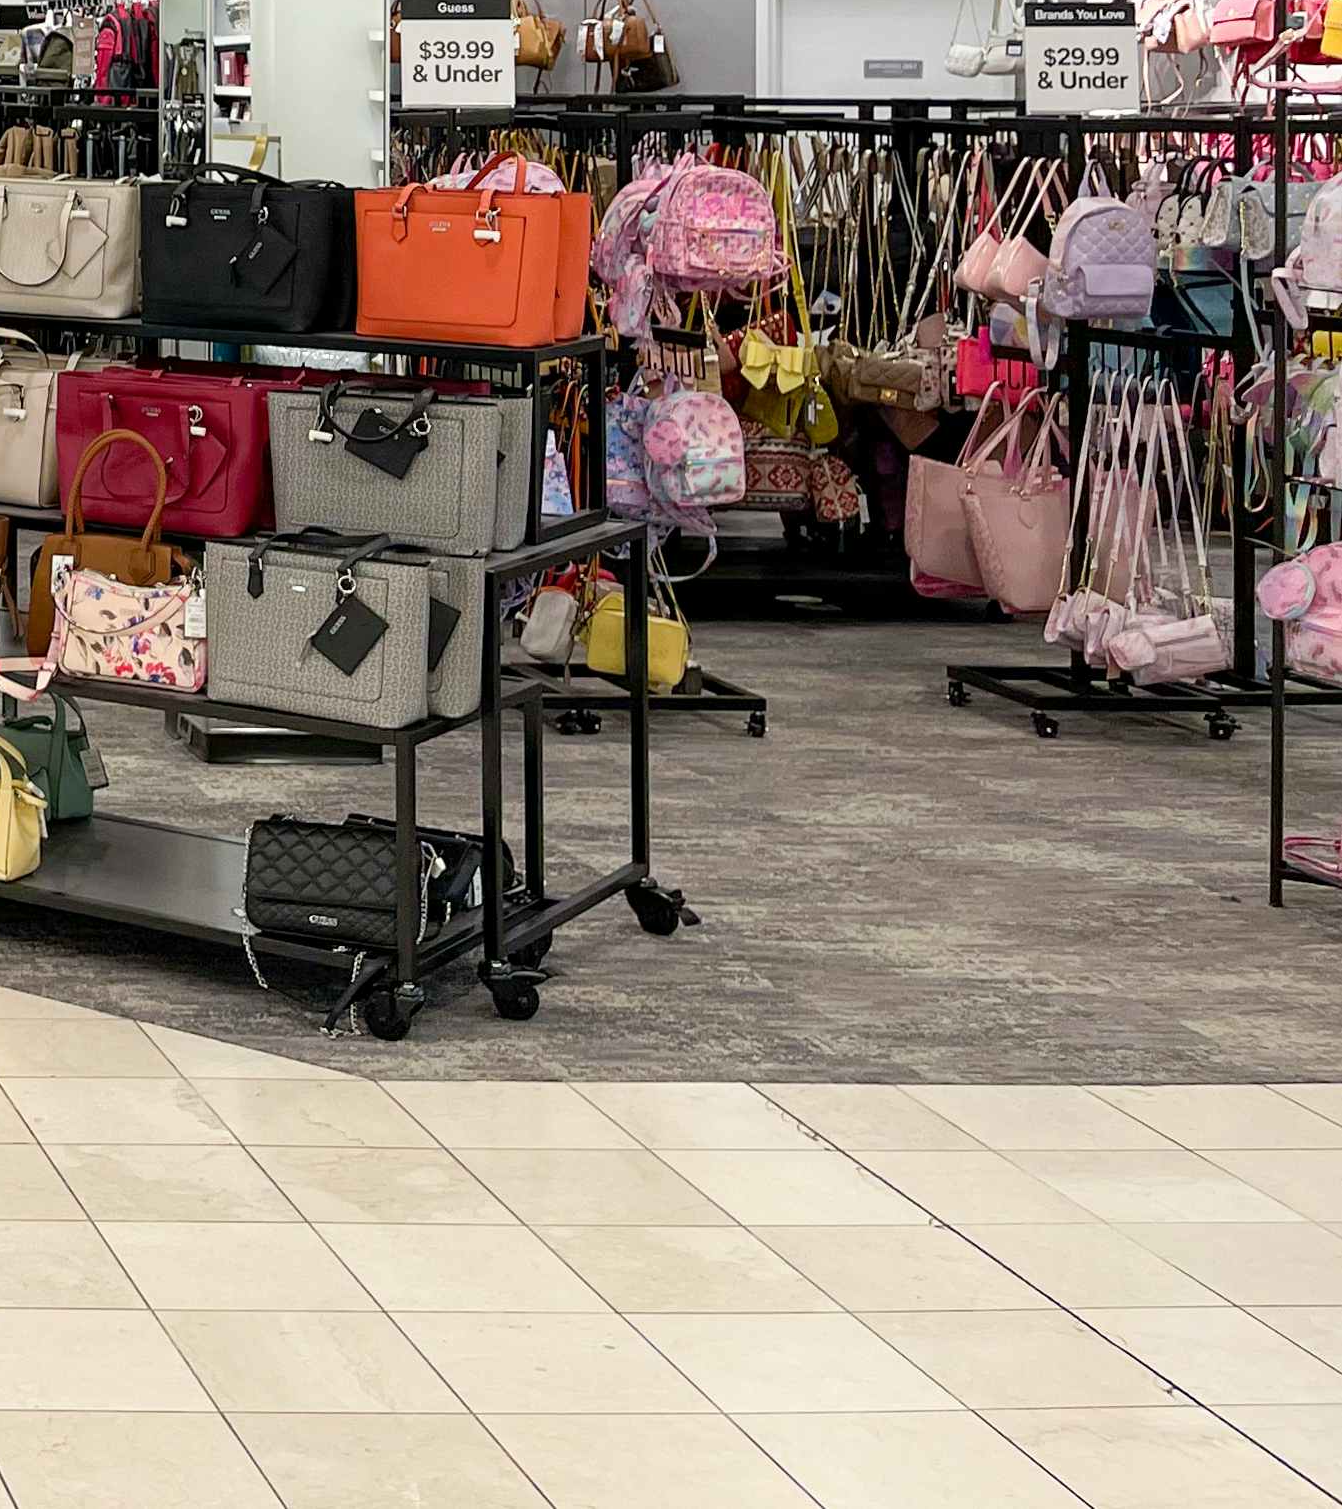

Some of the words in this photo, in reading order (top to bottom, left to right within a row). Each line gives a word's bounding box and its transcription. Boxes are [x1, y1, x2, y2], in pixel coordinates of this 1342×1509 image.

[437, 1, 475, 14] Guess
[1035, 8, 1074, 21] Brands
[1075, 8, 1097, 20] You
[1098, 8, 1126, 20] Love
[418, 40, 495, 63] $39.99
[1043, 47, 1120, 67] $29.99
[412, 63, 428, 83] &
[434, 64, 503, 83] Under
[1037, 70, 1054, 90] &
[1060, 70, 1129, 90] Under
